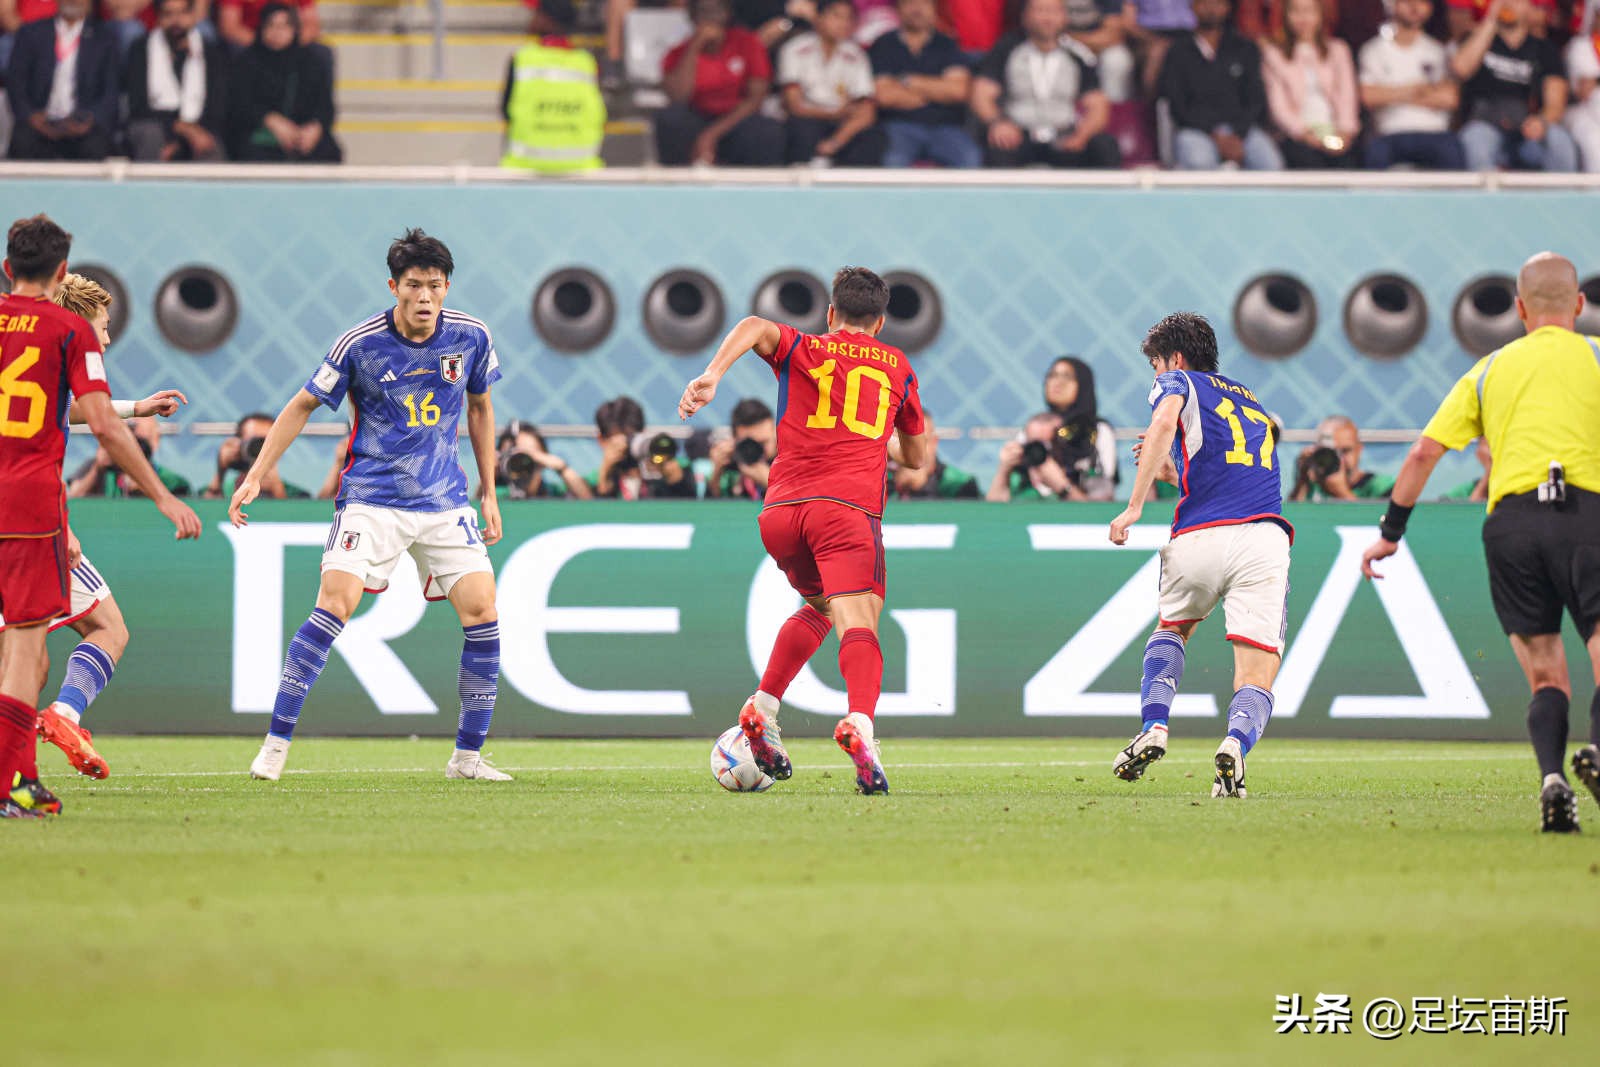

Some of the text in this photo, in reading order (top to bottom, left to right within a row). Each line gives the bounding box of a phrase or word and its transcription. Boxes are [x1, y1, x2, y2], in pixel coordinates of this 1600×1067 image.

[0, 313, 40, 333] EDRI
[826, 341, 898, 368] ASENSIO
[0, 345, 48, 439] 6
[403, 391, 441, 427] 16
[806, 358, 892, 440] 10
[1214, 397, 1274, 471] 17
[219, 521, 1492, 720] REGZA
